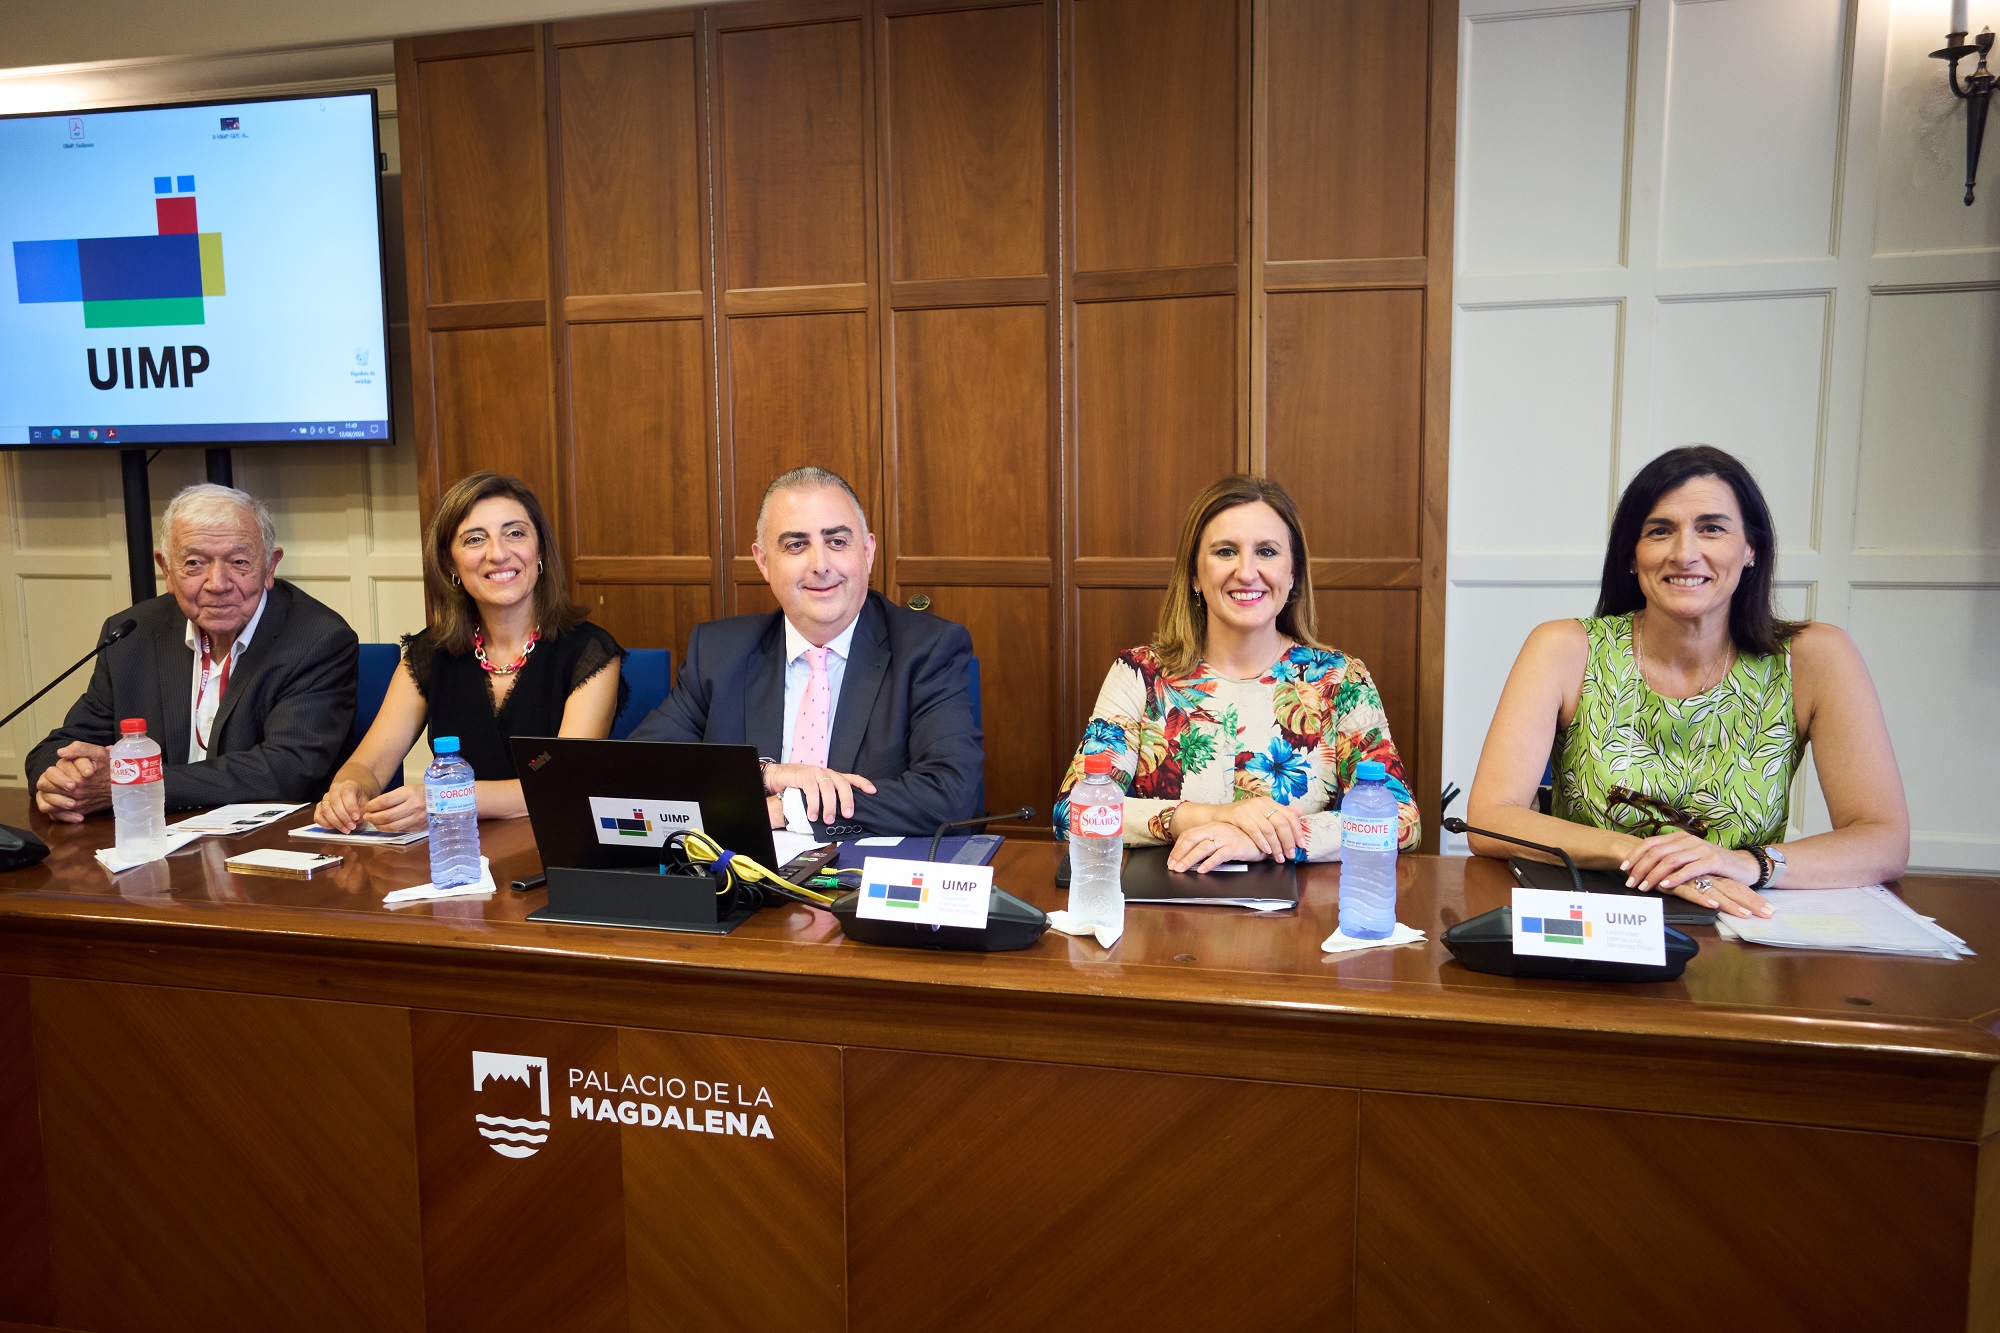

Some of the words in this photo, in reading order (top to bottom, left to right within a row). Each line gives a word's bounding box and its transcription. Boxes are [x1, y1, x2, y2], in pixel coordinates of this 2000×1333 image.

[87, 345, 210, 390] UIMP
[660, 813, 690, 823] UIMP
[1342, 820, 1389, 834] CORCONTE
[942, 879, 977, 892] UIMP
[1606, 912, 1647, 926] UIMP
[568, 1068, 687, 1099] PALACIO
[693, 1080, 730, 1104] DE
[737, 1084, 774, 1109] LA
[569, 1095, 775, 1140] MAGDALENA
